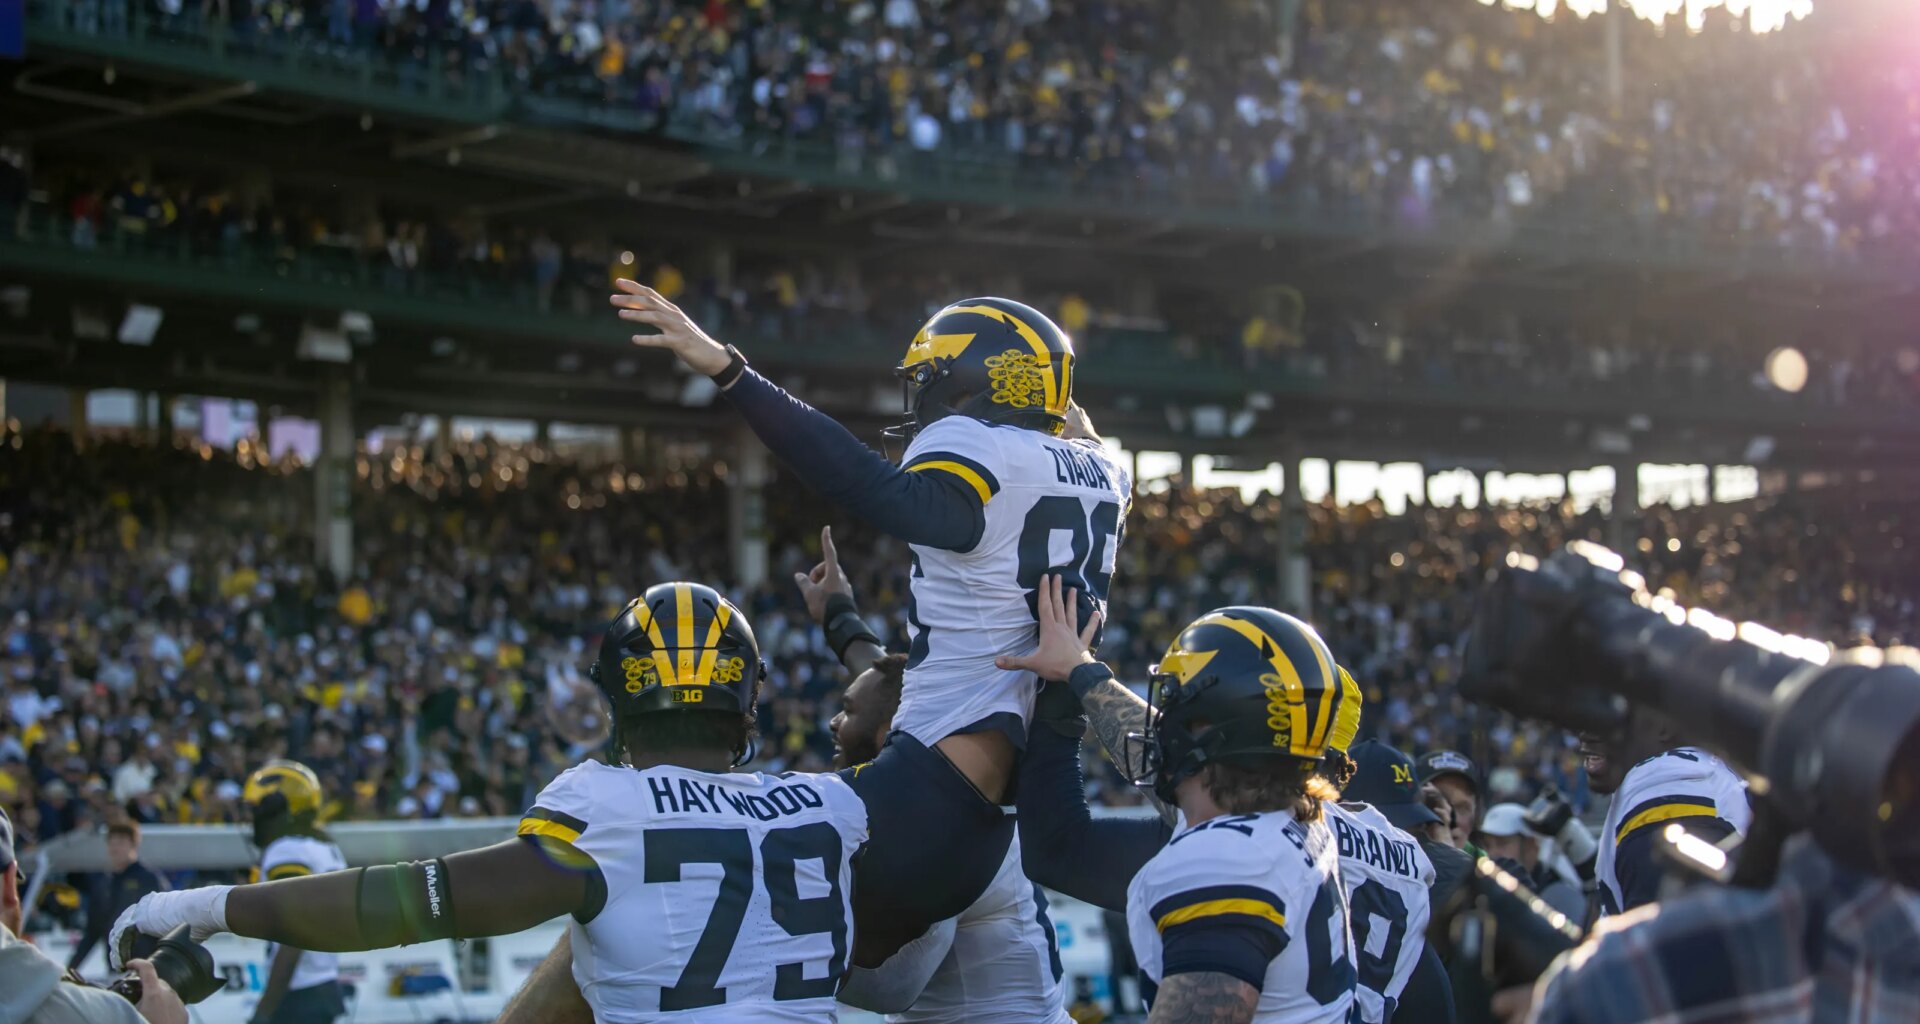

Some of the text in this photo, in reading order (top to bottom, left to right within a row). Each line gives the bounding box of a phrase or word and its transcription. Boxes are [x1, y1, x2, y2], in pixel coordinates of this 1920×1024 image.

[1031, 393, 1044, 407] 96
[1043, 444, 1111, 490] ZVADA
[643, 673, 657, 685] 79
[1273, 733, 1289, 747] 92
[1391, 763, 1413, 783] M
[648, 776, 824, 822] HAYWOOD
[1333, 815, 1419, 880] BRANDT
[643, 821, 848, 1013] 79
